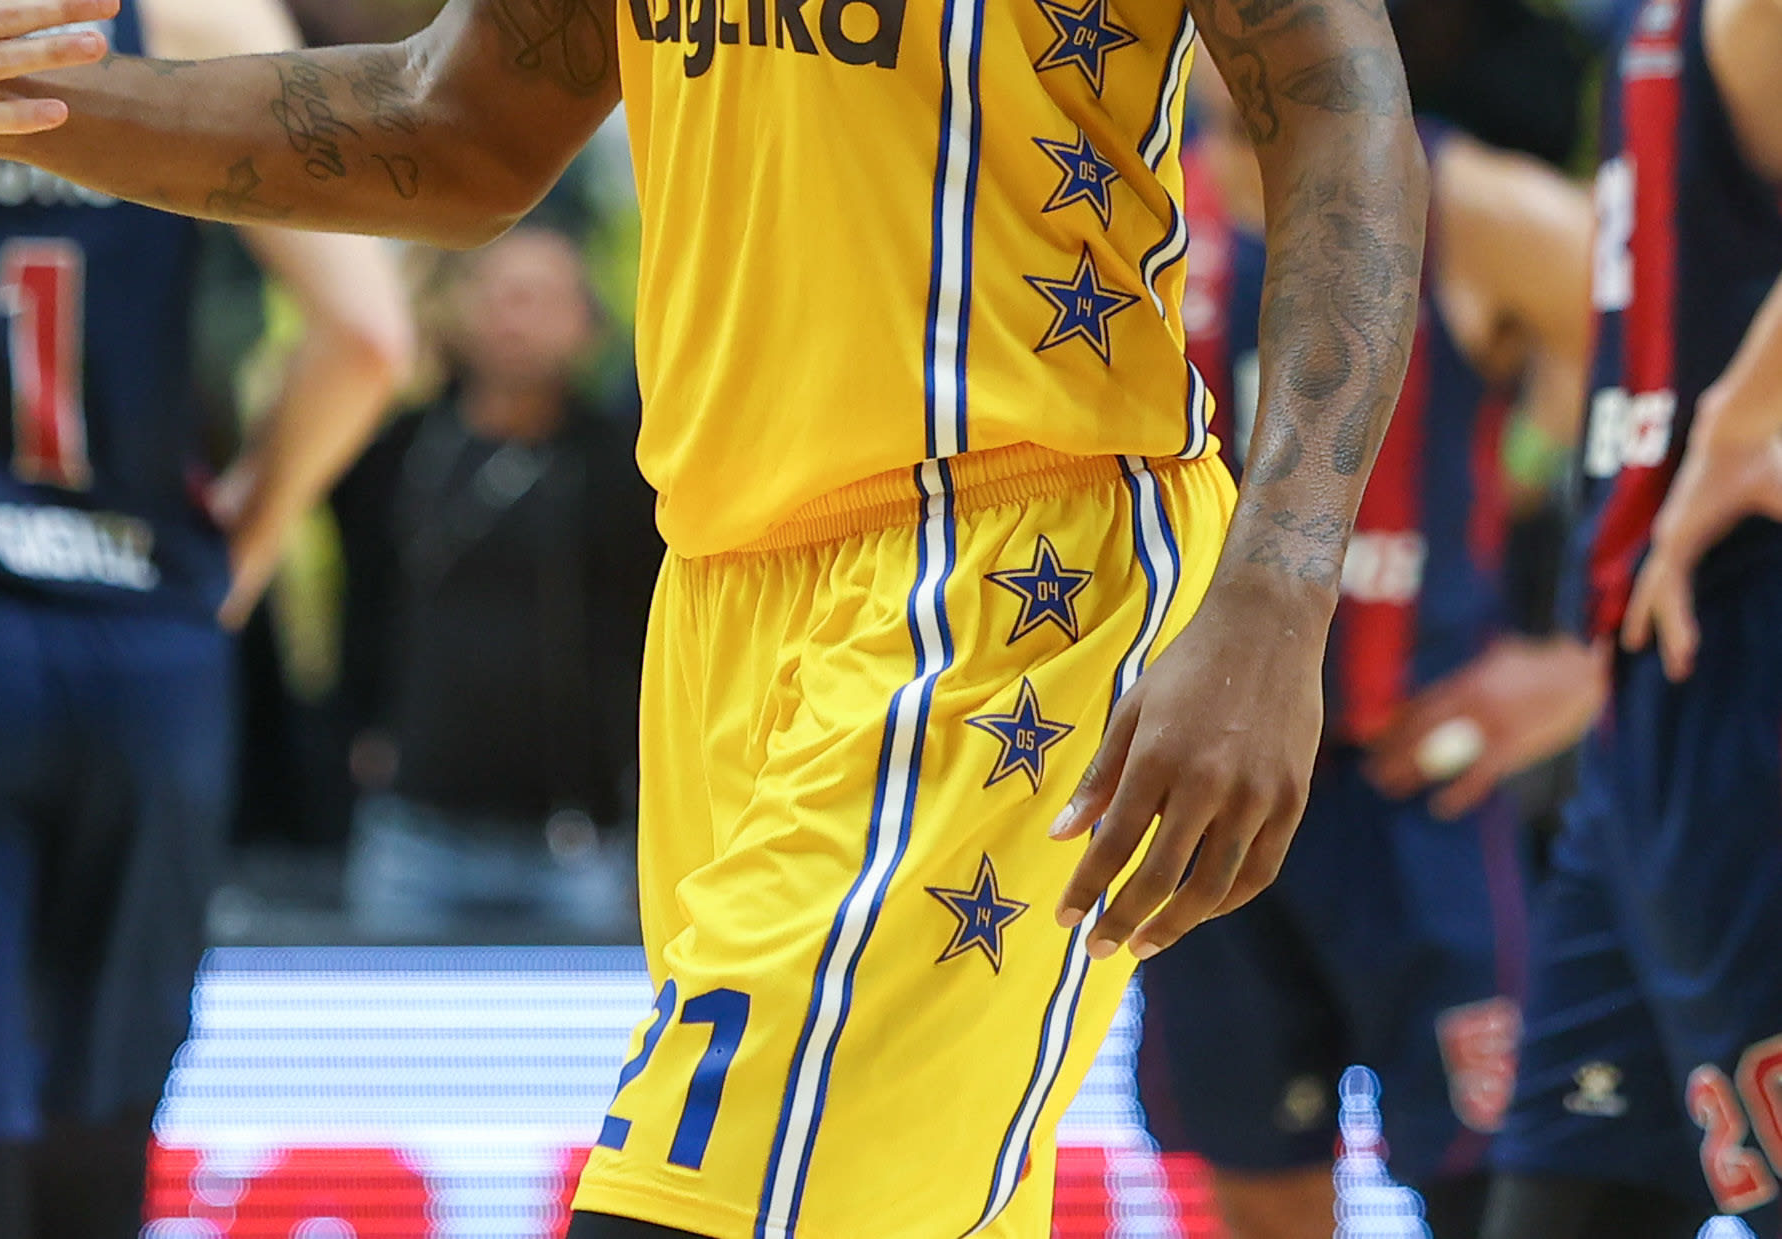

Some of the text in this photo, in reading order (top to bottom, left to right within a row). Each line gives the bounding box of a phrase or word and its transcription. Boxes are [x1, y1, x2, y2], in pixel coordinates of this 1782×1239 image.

[1073, 27, 1098, 50] 04
[1078, 161, 1097, 183] 05
[1075, 295, 1092, 318] 14
[1037, 580, 1059, 602] 04
[1015, 728, 1035, 751] 05
[974, 905, 993, 928] 14
